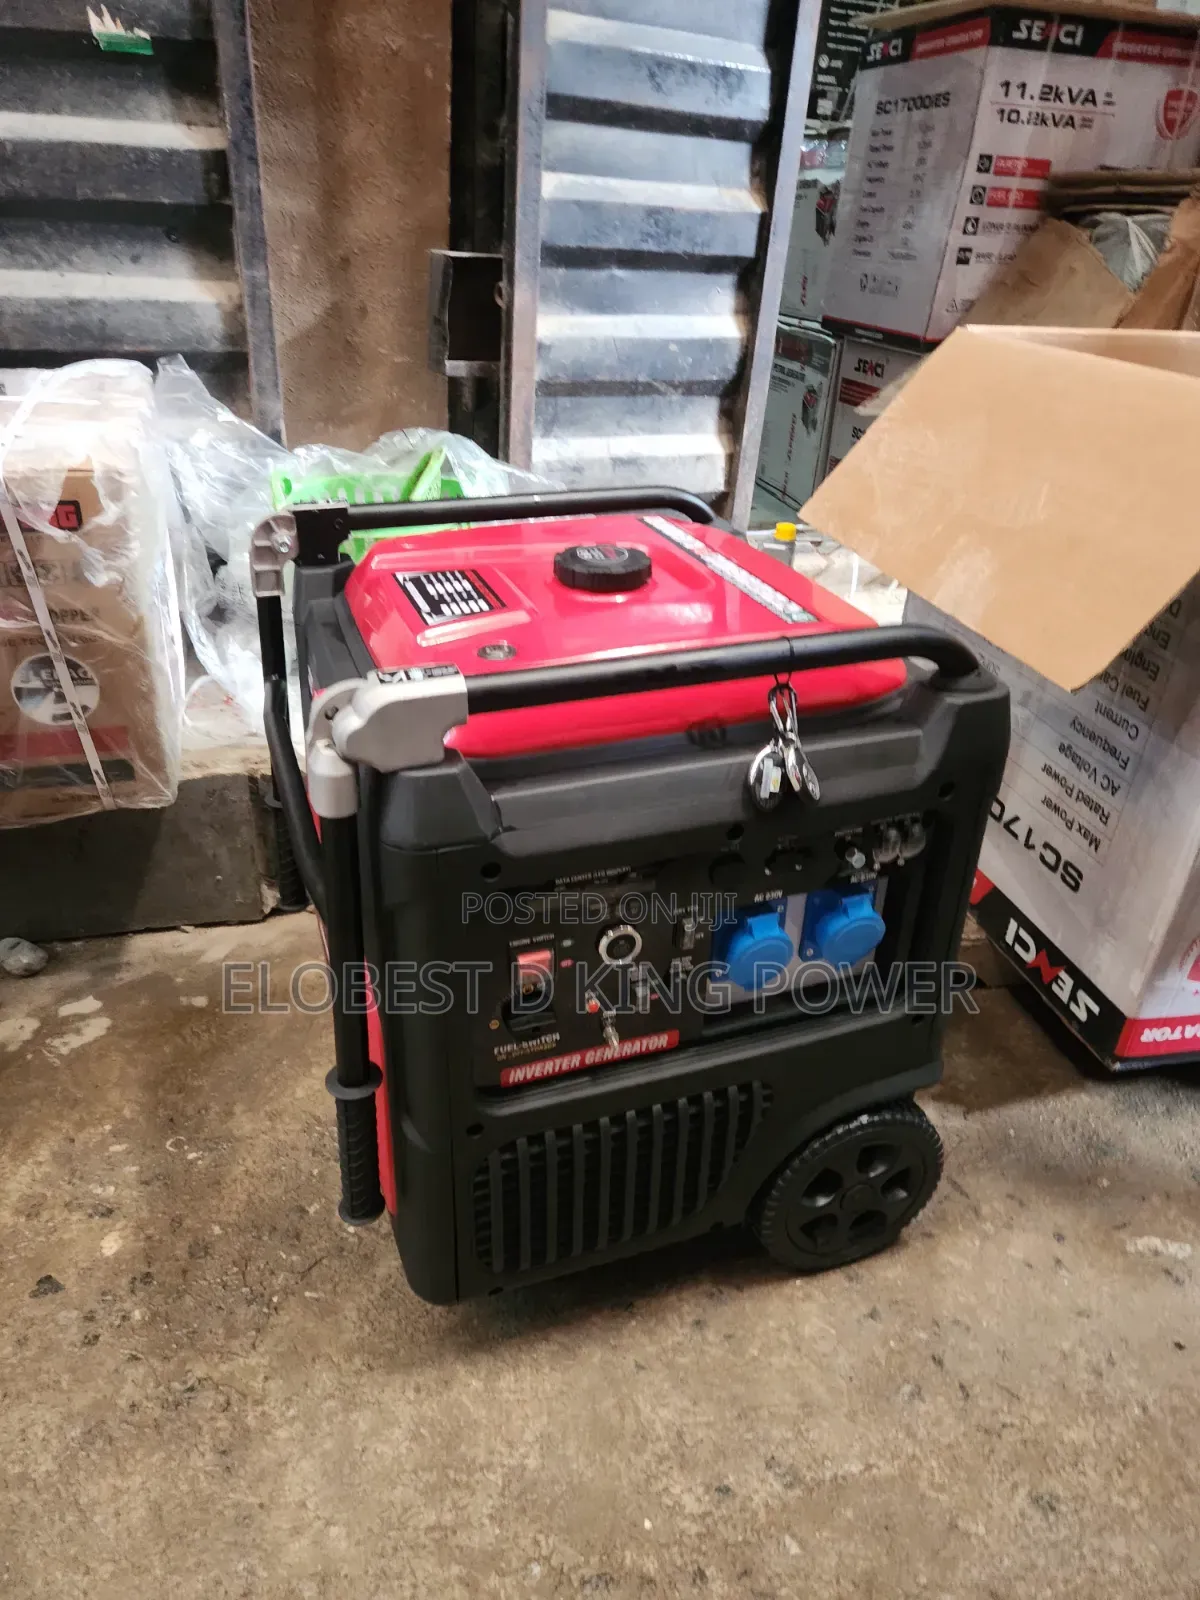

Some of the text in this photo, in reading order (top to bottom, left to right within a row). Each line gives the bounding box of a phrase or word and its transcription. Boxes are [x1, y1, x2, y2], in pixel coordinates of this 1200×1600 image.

[1094, 700, 1139, 741] Current
[1120, 683, 1150, 713] Fuel
[1058, 742, 1121, 797] AC Voltage
[1069, 715, 1130, 771] Frequency
[1041, 762, 1111, 826] Rated Power
[1041, 794, 1101, 854] Max Power
[1005, 917, 1100, 1023] SENCI
[508, 1054, 581, 1084] INVERTER
[585, 1034, 669, 1064] GENERATOR
